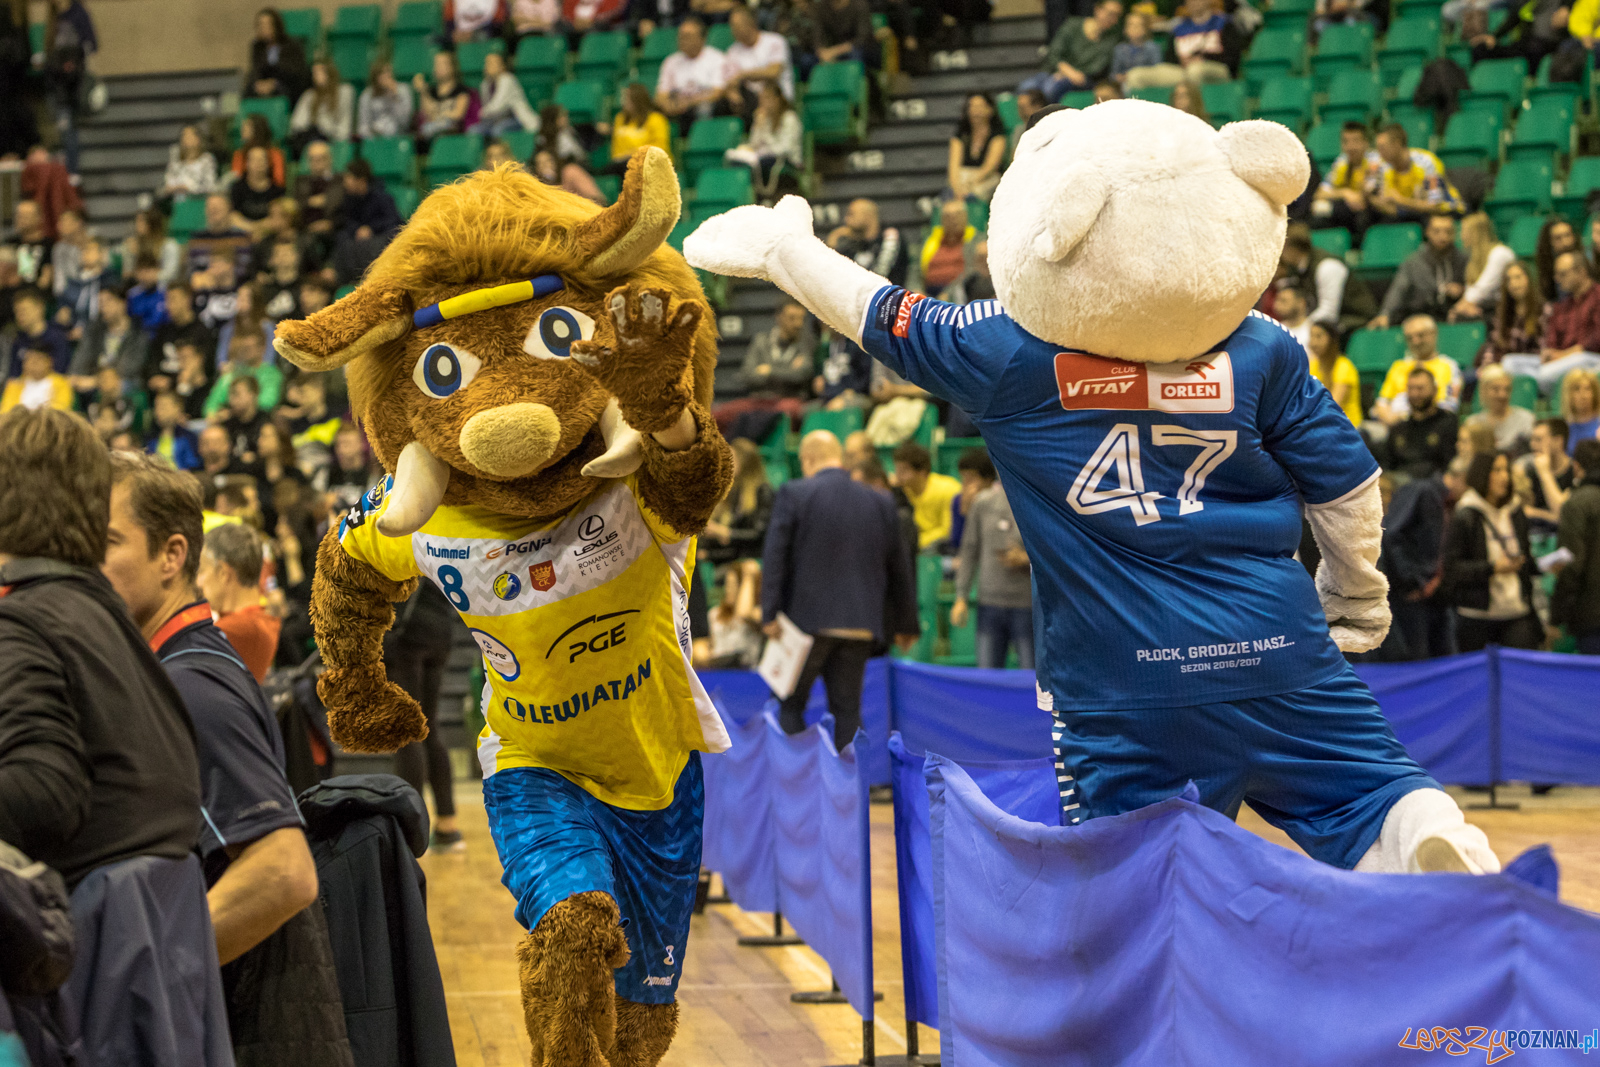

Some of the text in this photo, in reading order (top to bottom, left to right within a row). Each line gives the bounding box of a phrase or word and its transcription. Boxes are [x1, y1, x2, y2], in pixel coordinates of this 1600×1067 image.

[1111, 366, 1137, 375] CLUB
[1066, 377, 1137, 397] VITAY
[1164, 385, 1217, 397] ORLEN
[1066, 423, 1238, 527] 47
[426, 541, 471, 560] hummel
[574, 530, 619, 557] LEXUS
[578, 543, 623, 569] ROMANOWSKI
[581, 551, 625, 577] KIELCE
[437, 564, 470, 612] 8
[538, 578, 550, 587] CK
[569, 622, 626, 663] PGE
[1136, 635, 1296, 662] PŁOCK, GRODZIE NASZ...
[1180, 657, 1261, 673] SEZON 2016/2017
[529, 657, 651, 724] LEWIATAN
